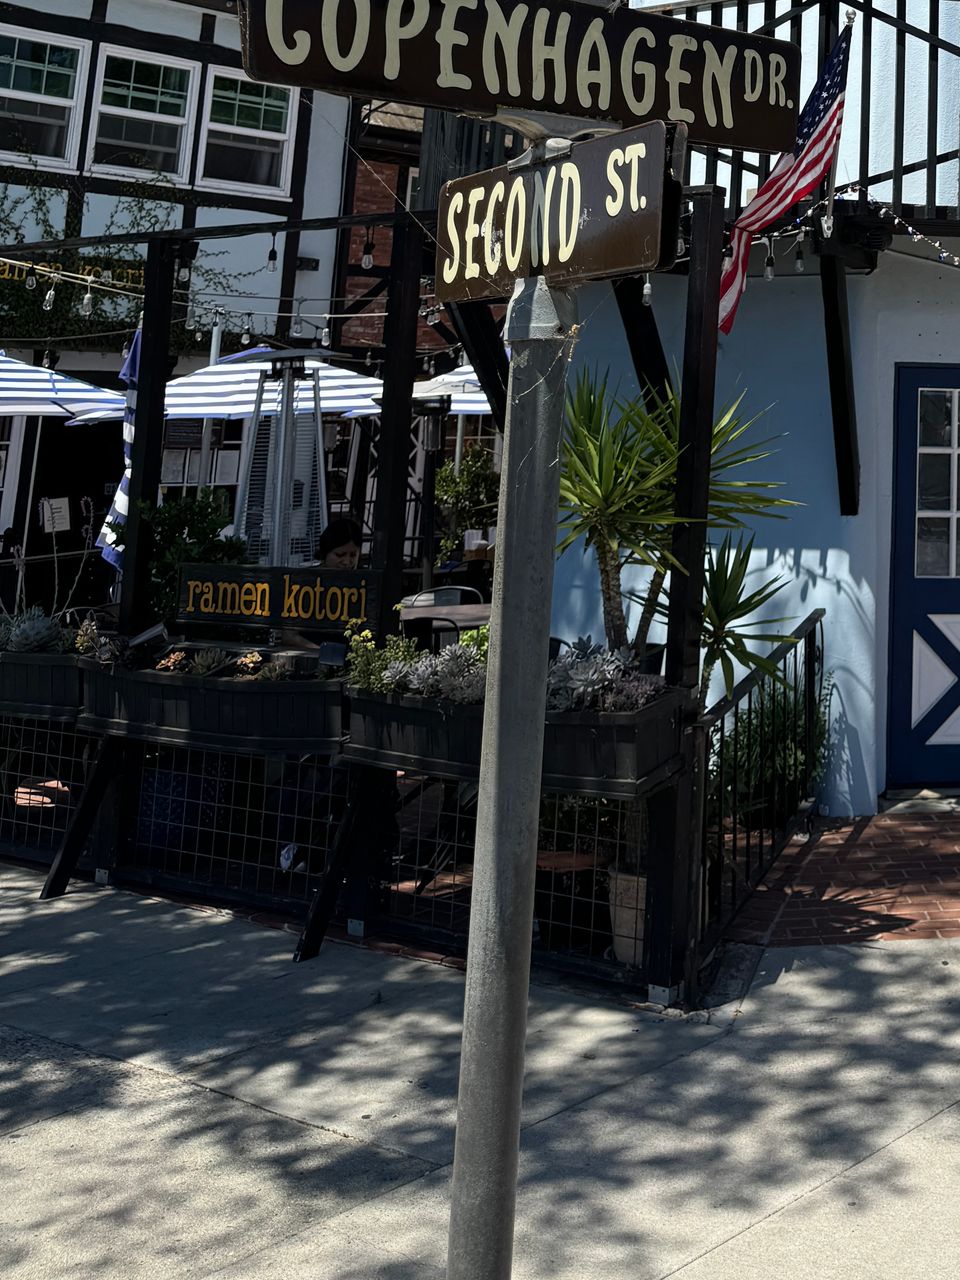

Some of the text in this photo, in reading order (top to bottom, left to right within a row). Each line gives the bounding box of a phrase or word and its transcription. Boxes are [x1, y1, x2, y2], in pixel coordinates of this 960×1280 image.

[743, 48, 794, 110] DR.
[443, 142, 647, 284] SECOND ST.
[186, 574, 367, 621] ramen kotori
